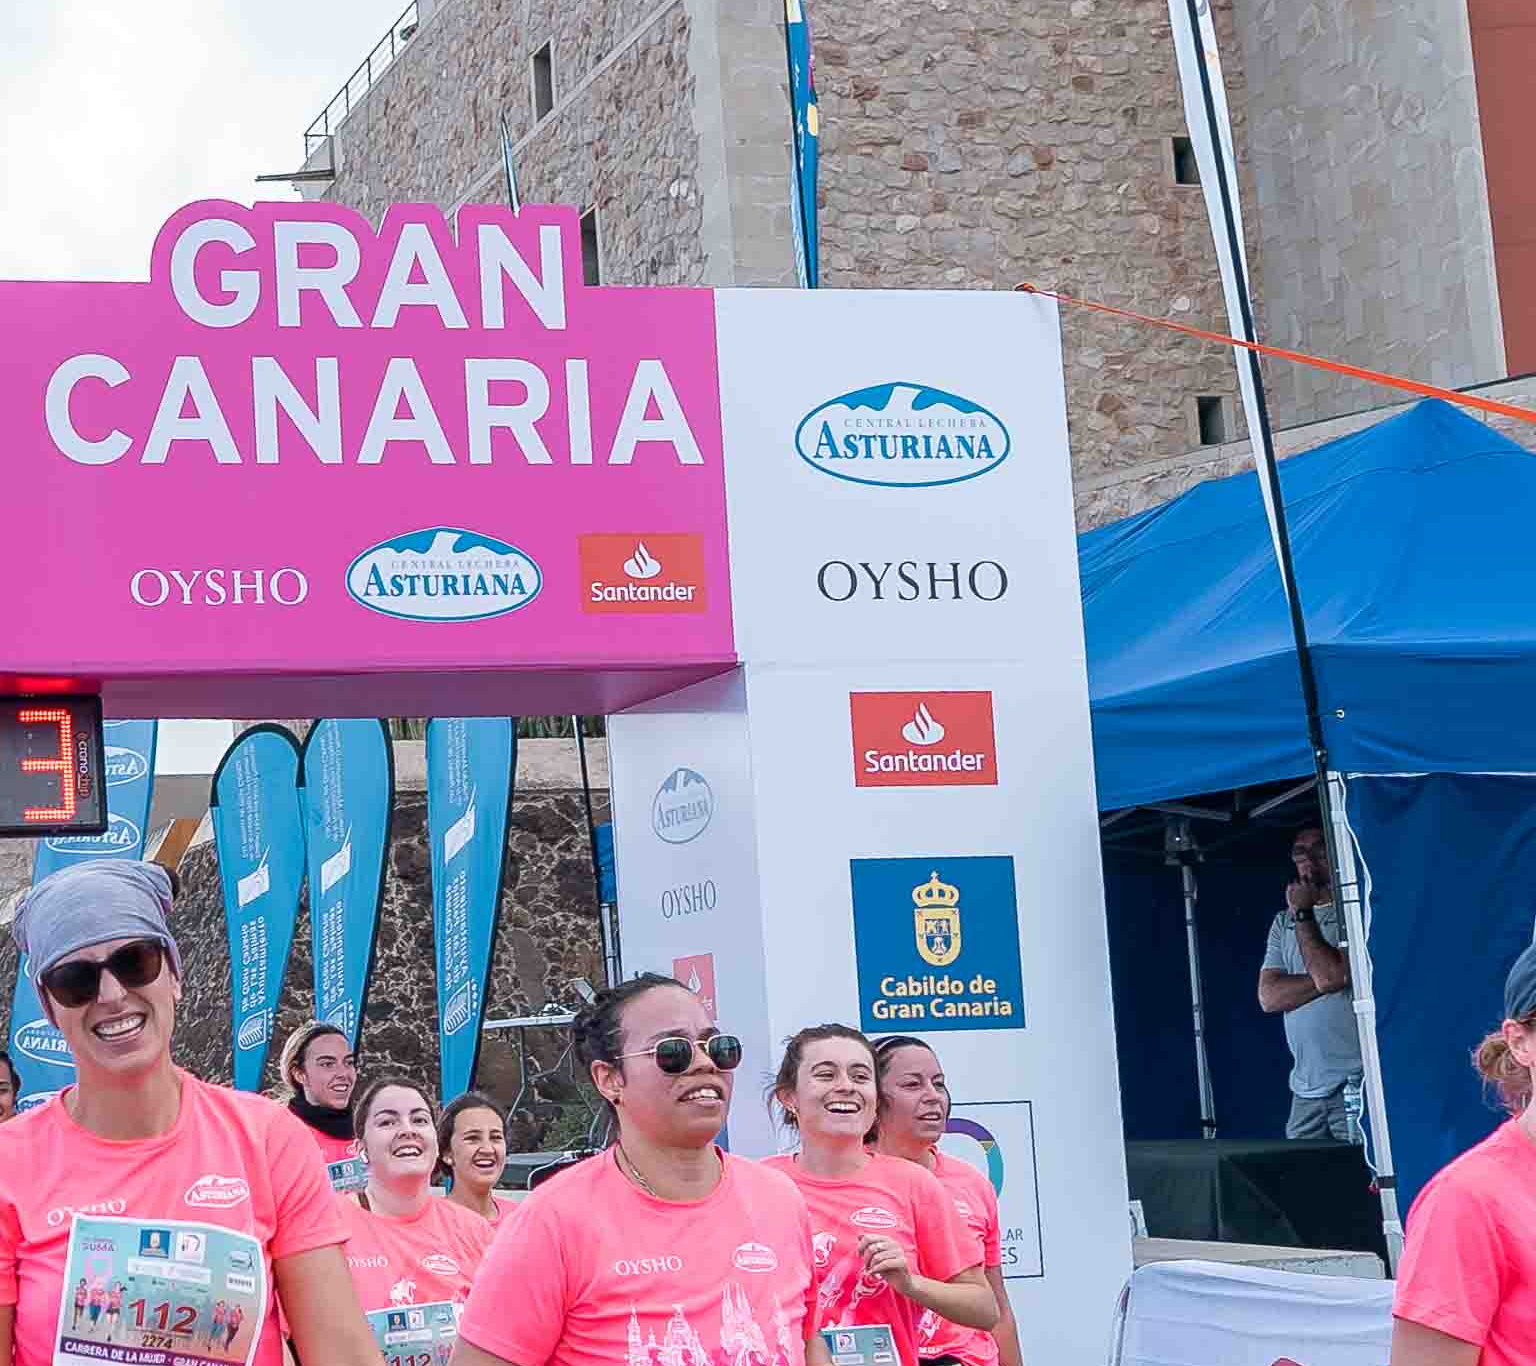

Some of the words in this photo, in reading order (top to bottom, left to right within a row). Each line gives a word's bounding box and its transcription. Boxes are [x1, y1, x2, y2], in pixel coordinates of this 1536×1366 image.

[169, 217, 568, 330] GRAN
[44, 352, 705, 467] CANARIA
[813, 421, 995, 459] ASTURIANA
[130, 567, 308, 606] OYSHO
[363, 562, 528, 597] ASTURIANA
[591, 580, 696, 603] Santander
[817, 560, 1008, 601] OYSHO
[864, 749, 985, 773] Santander
[661, 879, 718, 919] OYSHO
[880, 975, 964, 998] Cabildo
[969, 973, 996, 995] de
[872, 999, 924, 1020] Gran
[930, 996, 1013, 1019] Canaria
[615, 1255, 683, 1276] OYSHO
[129, 1298, 199, 1334] 112
[64, 1340, 109, 1359] CARRERA
[110, 1347, 125, 1361] DE
[126, 1349, 139, 1363] LA
[140, 1351, 166, 1366] MUJER
[142, 1334, 174, 1350] 2274
